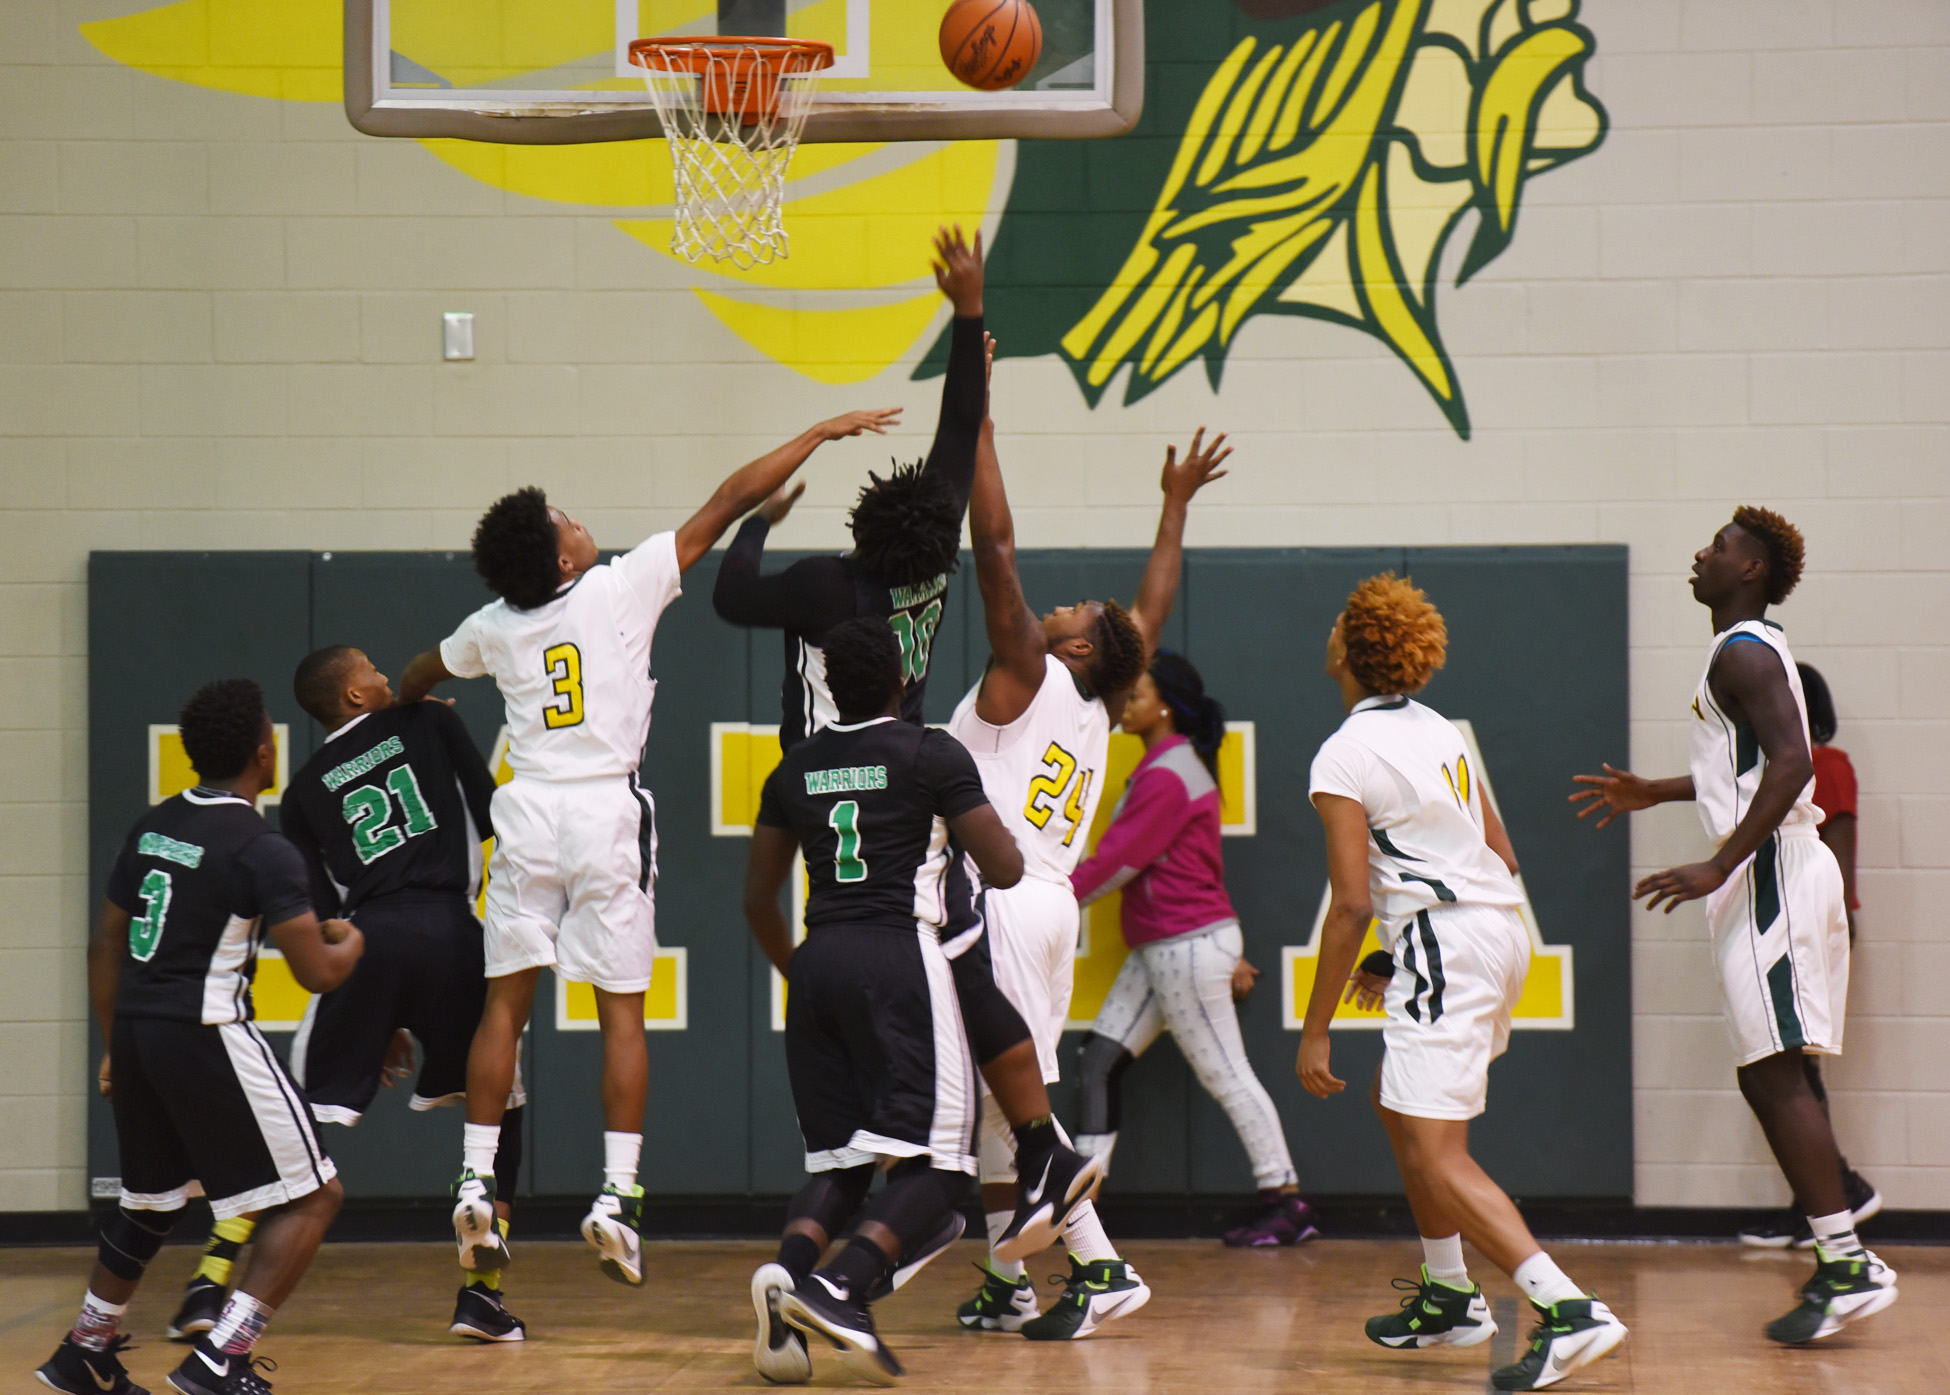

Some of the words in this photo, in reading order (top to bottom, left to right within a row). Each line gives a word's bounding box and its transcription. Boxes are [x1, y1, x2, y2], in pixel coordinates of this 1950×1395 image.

[542, 642, 584, 730] 3
[321, 735, 405, 792] WARRIORS
[804, 765, 888, 796] WARRIORS
[1023, 740, 1094, 848] 24
[342, 763, 439, 866] 21
[828, 800, 868, 883] 1
[128, 869, 173, 963] 3
